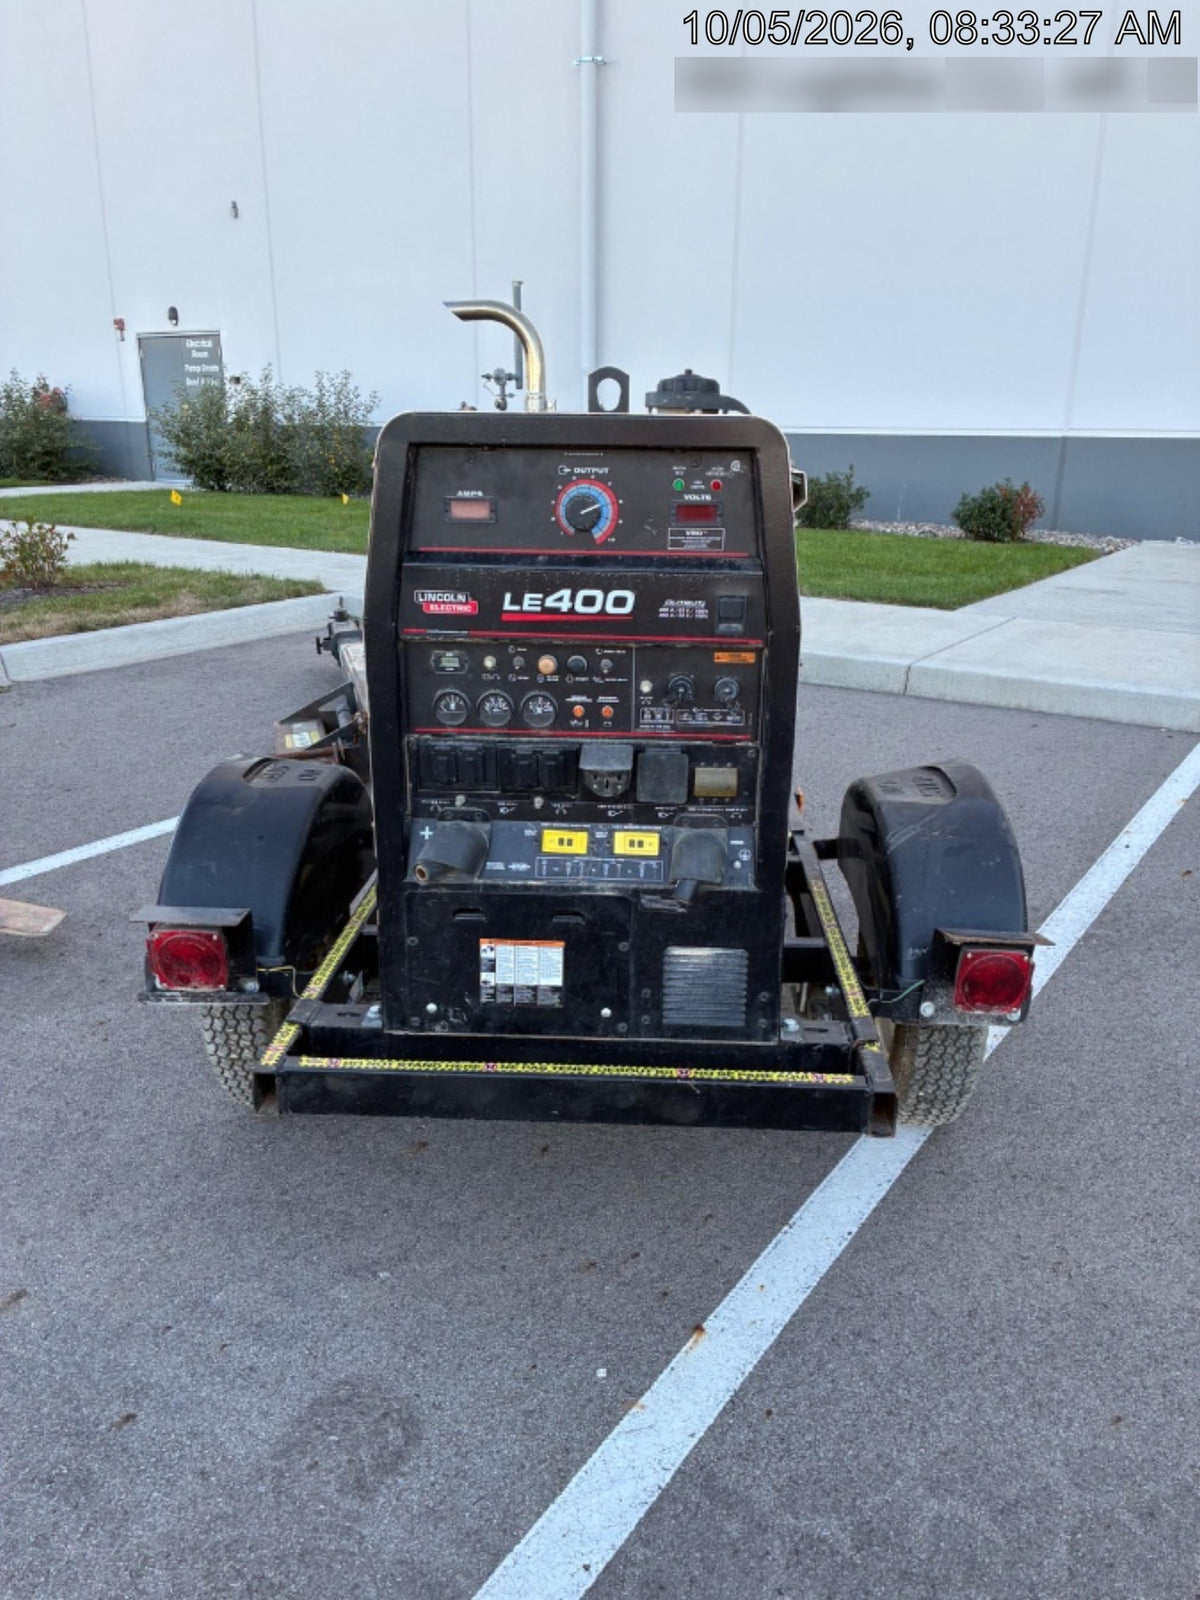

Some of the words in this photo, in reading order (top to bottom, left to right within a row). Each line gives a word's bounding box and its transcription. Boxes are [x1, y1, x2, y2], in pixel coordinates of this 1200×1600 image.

[573, 466, 610, 474] OUTPUT
[683, 493, 712, 501] VOLTS
[417, 592, 467, 604] LINCOLN
[502, 588, 636, 615] LE400
[428, 603, 473, 614] ELECTRIC
